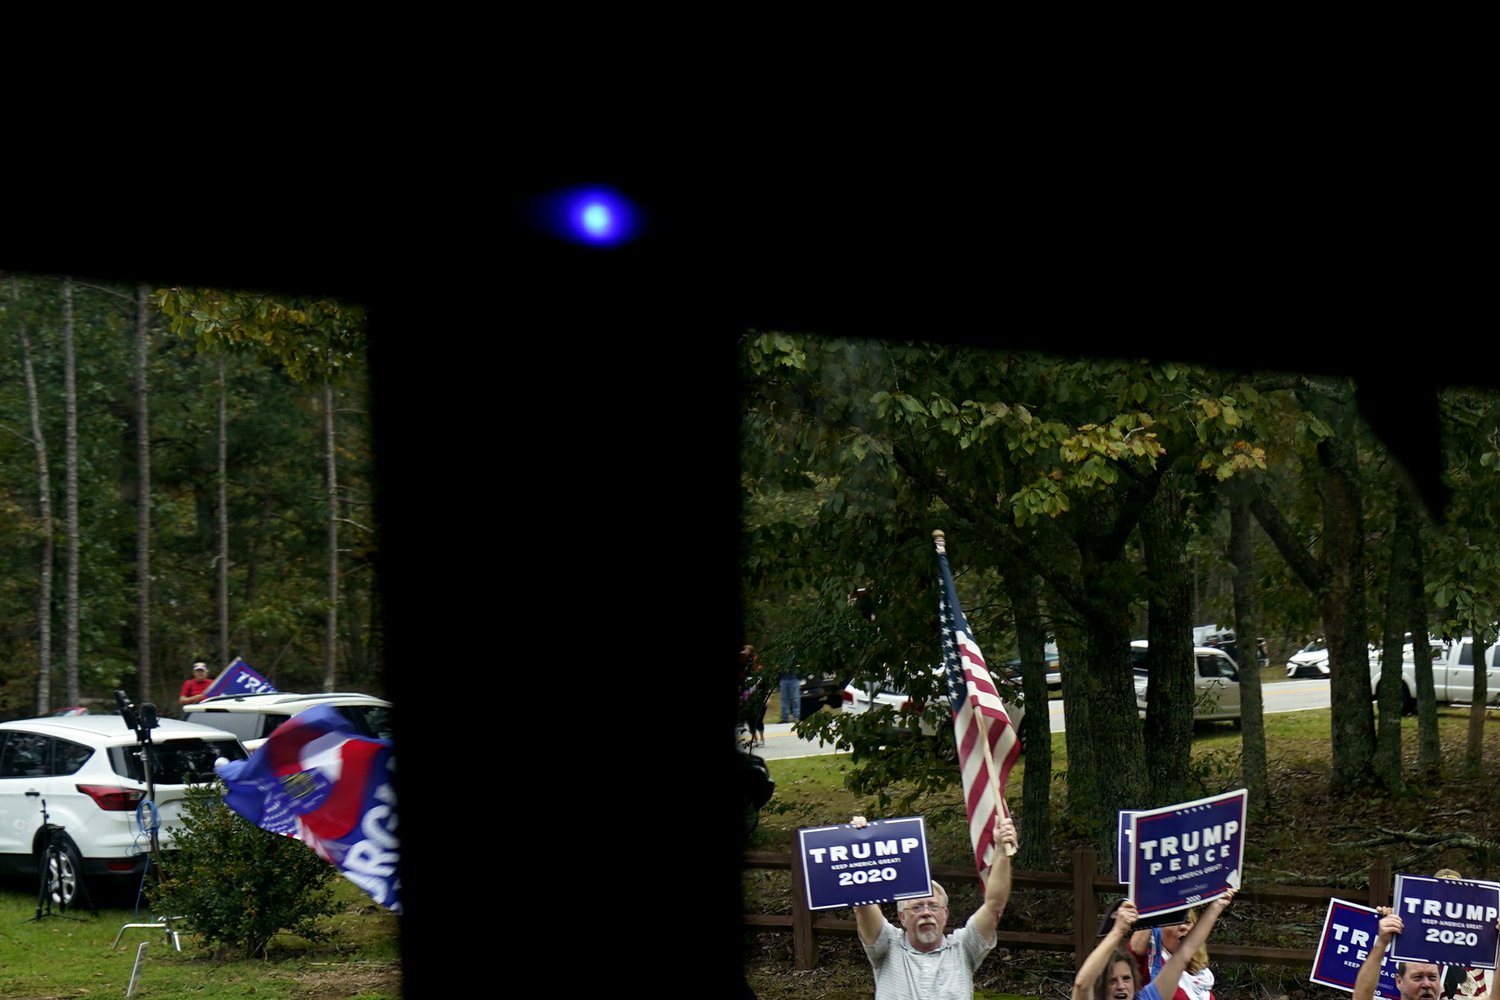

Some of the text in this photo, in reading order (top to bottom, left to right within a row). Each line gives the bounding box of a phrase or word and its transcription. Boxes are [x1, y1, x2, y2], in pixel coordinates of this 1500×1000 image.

[809, 838, 919, 863] TRUMP
[1140, 821, 1239, 860] TRUMP
[1150, 845, 1230, 875] PENCE
[839, 867, 897, 886] 2020
[1404, 897, 1498, 922] TRUMP
[1425, 928, 1478, 947] 2020
